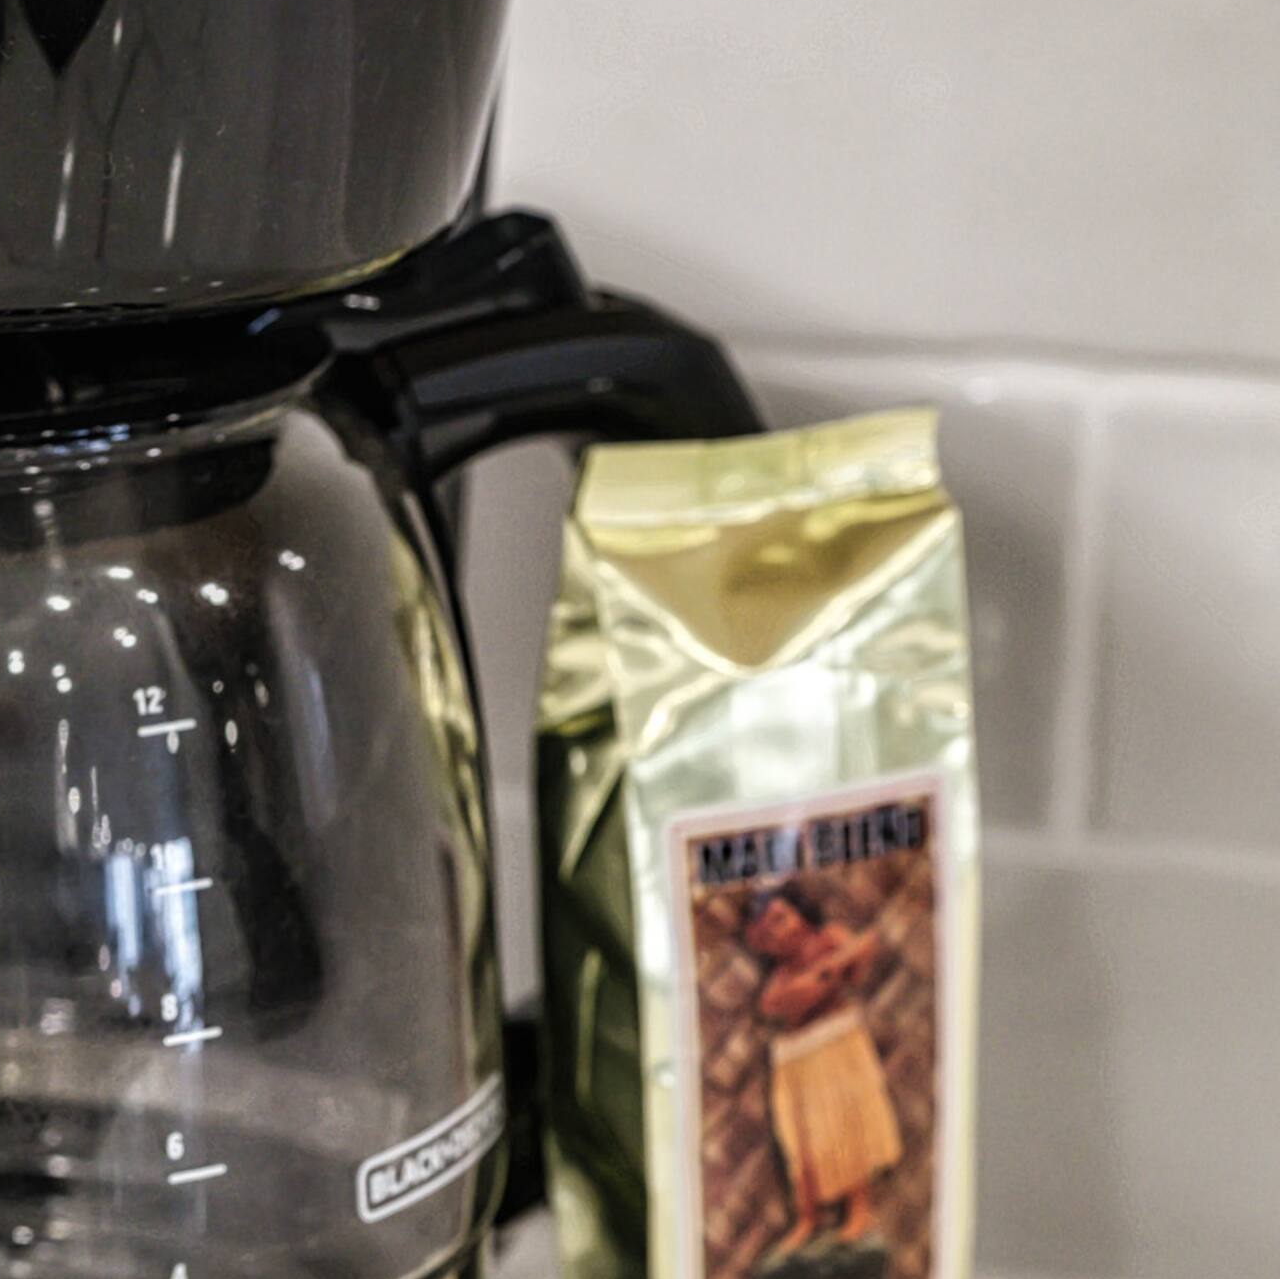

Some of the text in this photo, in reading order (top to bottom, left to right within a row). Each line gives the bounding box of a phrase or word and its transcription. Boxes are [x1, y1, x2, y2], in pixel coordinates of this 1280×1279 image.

[132, 685, 165, 717] 12
[160, 992, 179, 1022] 8
[165, 1130, 185, 1161] 6
